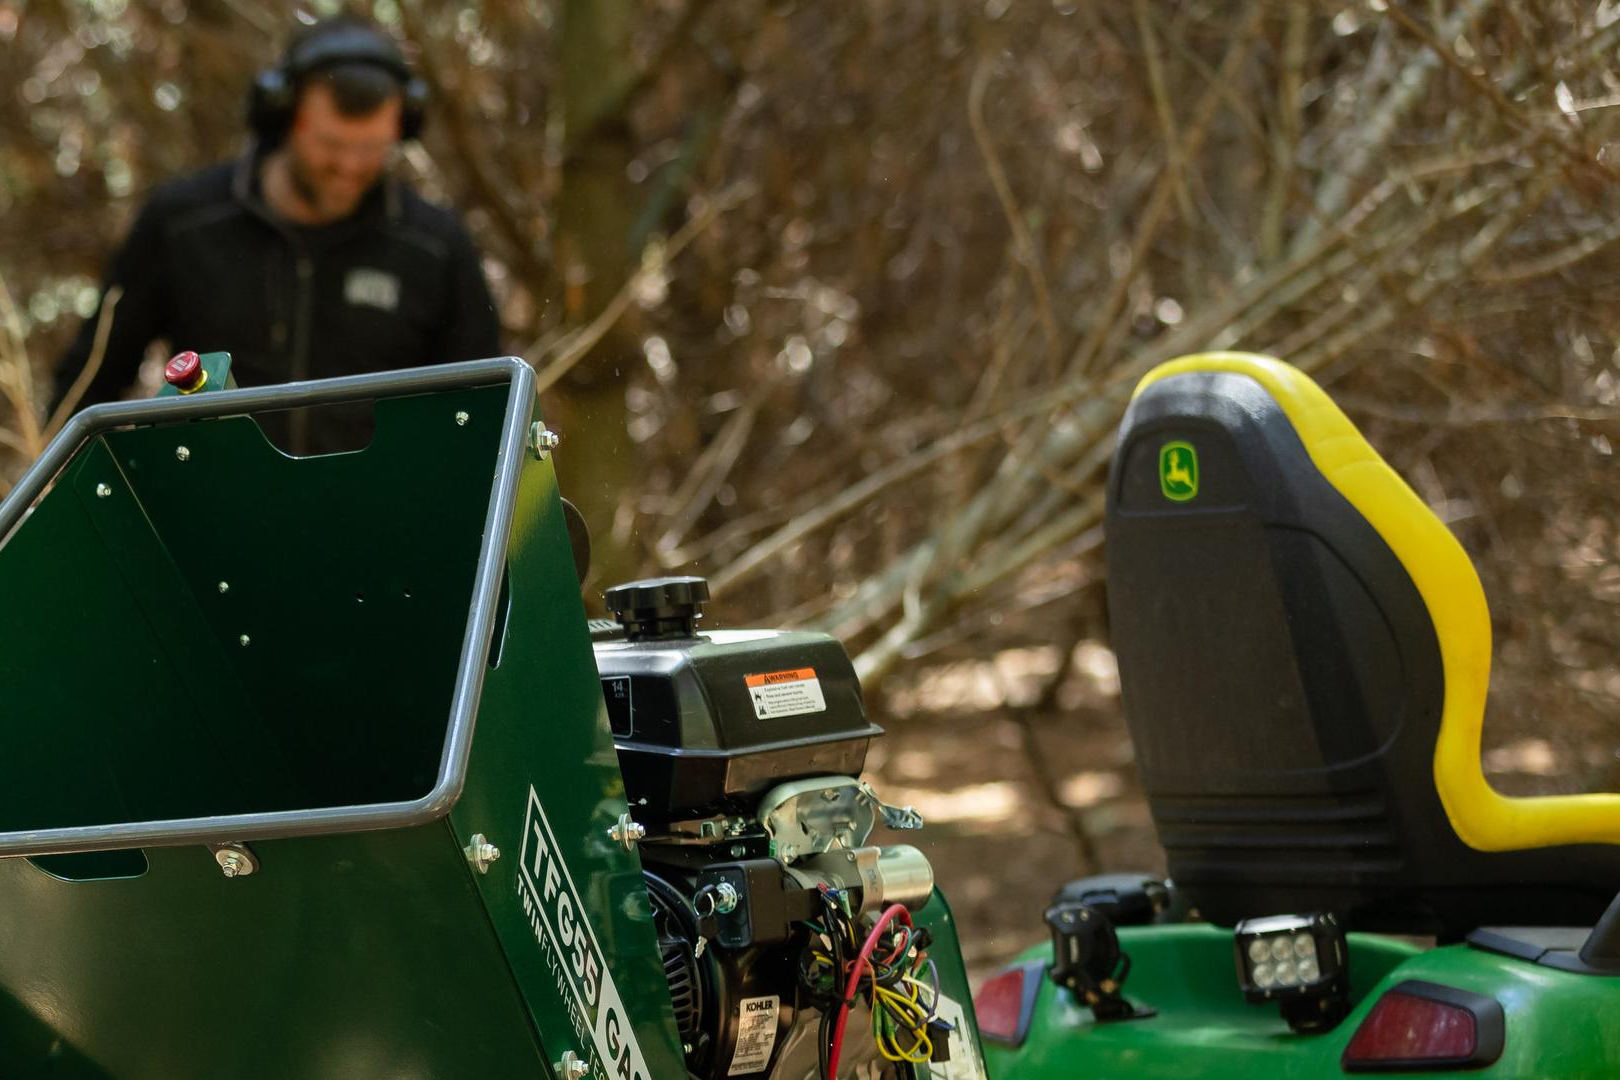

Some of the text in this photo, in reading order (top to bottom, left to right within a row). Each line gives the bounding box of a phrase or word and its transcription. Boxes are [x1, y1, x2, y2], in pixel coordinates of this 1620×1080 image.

[769, 671, 799, 682] WARNING
[612, 681, 623, 693] 14
[533, 819, 599, 1006] TFG55
[517, 873, 586, 1050] TWINFLYWHEEL
[746, 1000, 773, 1012] KOHLER
